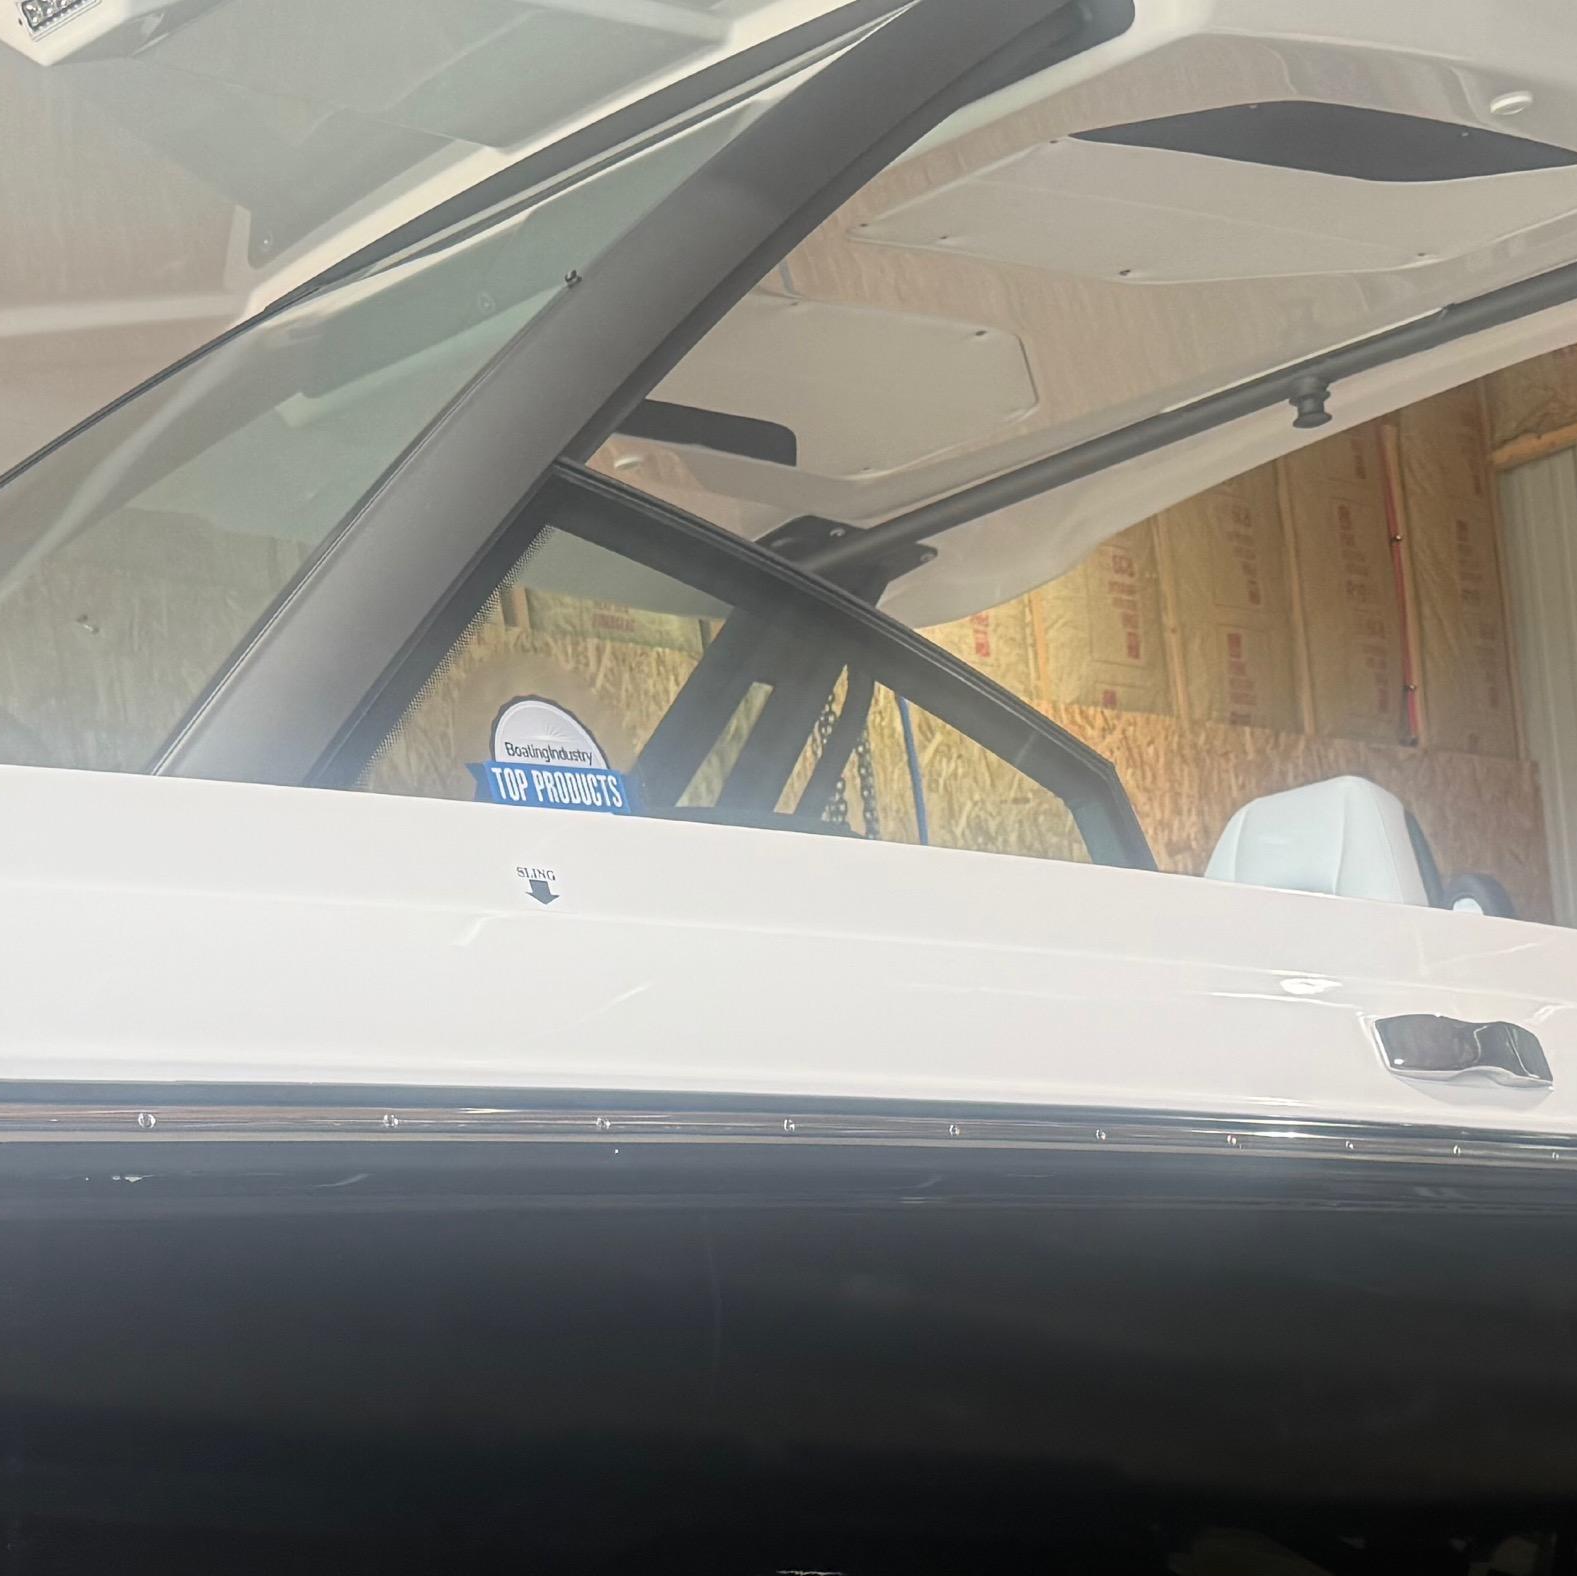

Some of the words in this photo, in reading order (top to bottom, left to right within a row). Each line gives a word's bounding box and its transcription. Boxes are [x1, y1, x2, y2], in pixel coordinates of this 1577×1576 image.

[491, 767, 529, 801] TOP
[531, 770, 623, 808] PRODUCTS
[516, 866, 556, 881] SLING
